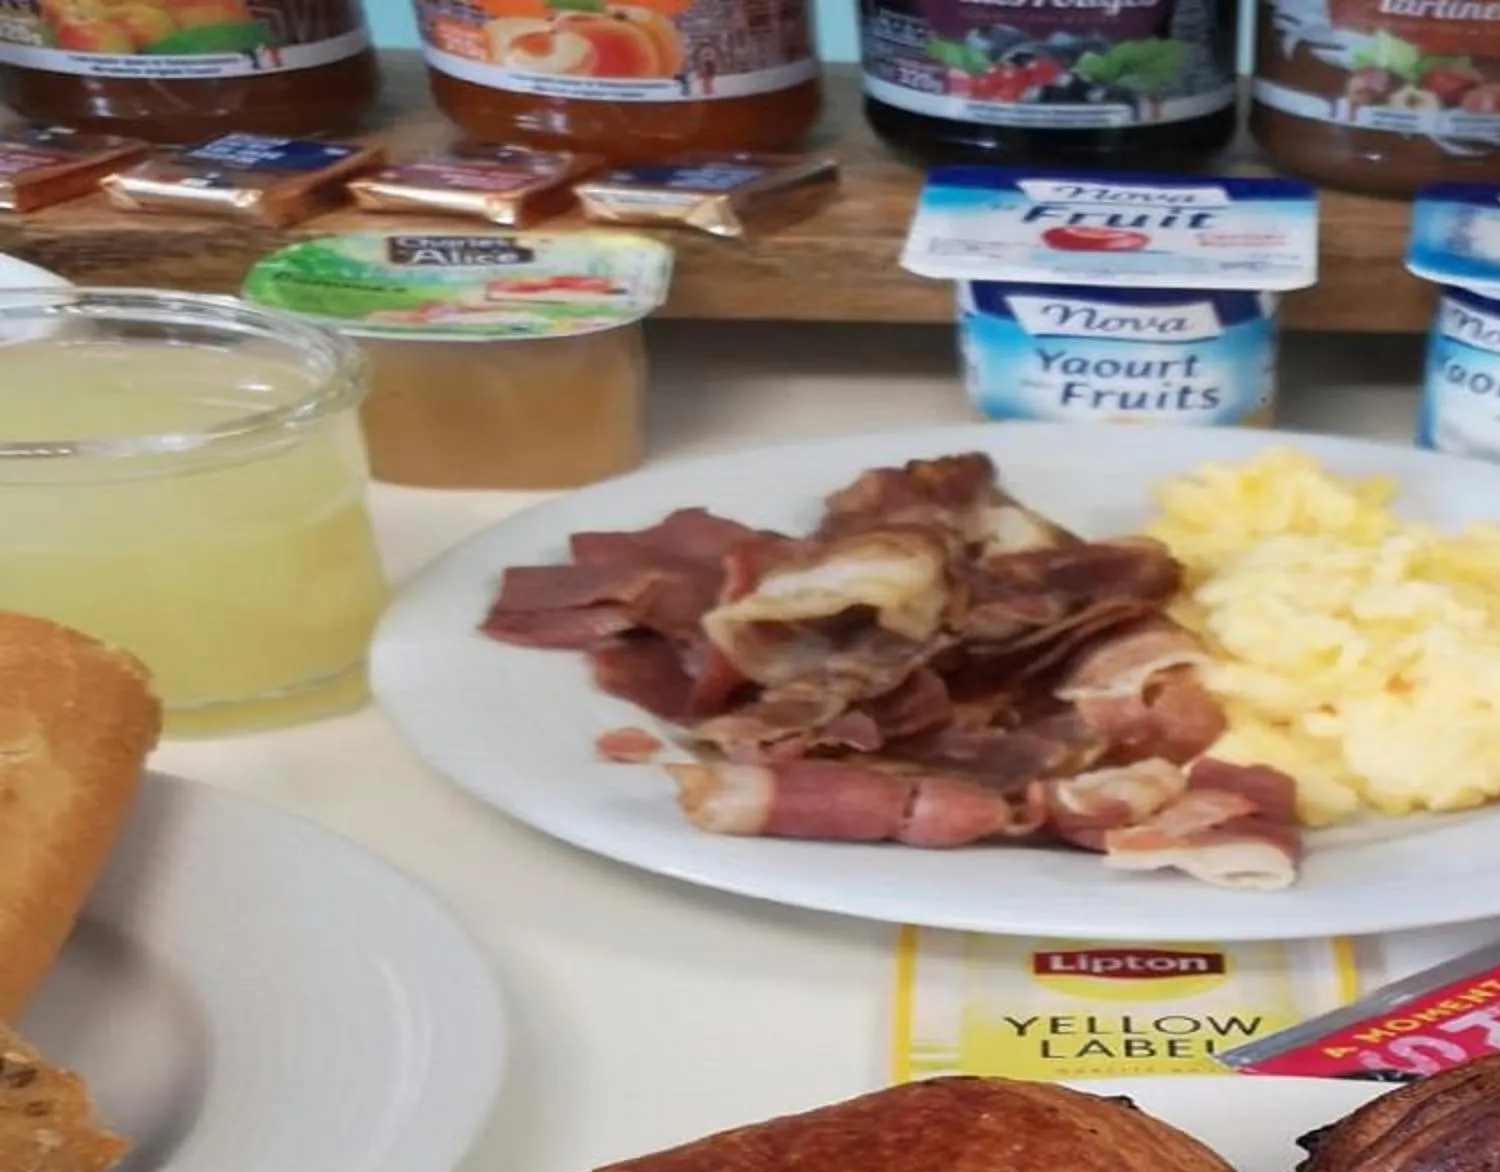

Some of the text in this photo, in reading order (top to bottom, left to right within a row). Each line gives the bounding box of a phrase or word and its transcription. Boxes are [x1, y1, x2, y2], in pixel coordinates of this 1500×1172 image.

[1052, 184, 1197, 204] Nova
[1020, 204, 1218, 229] Fruit
[411, 249, 520, 266] Alice
[1041, 302, 1193, 334] Nova
[1034, 348, 1202, 379] Yaourt
[1060, 381, 1222, 411] Fruits
[1049, 953, 1209, 974] Lipton
[1003, 1015, 1263, 1037] YELLOW
[1322, 1042, 1357, 1060] A
